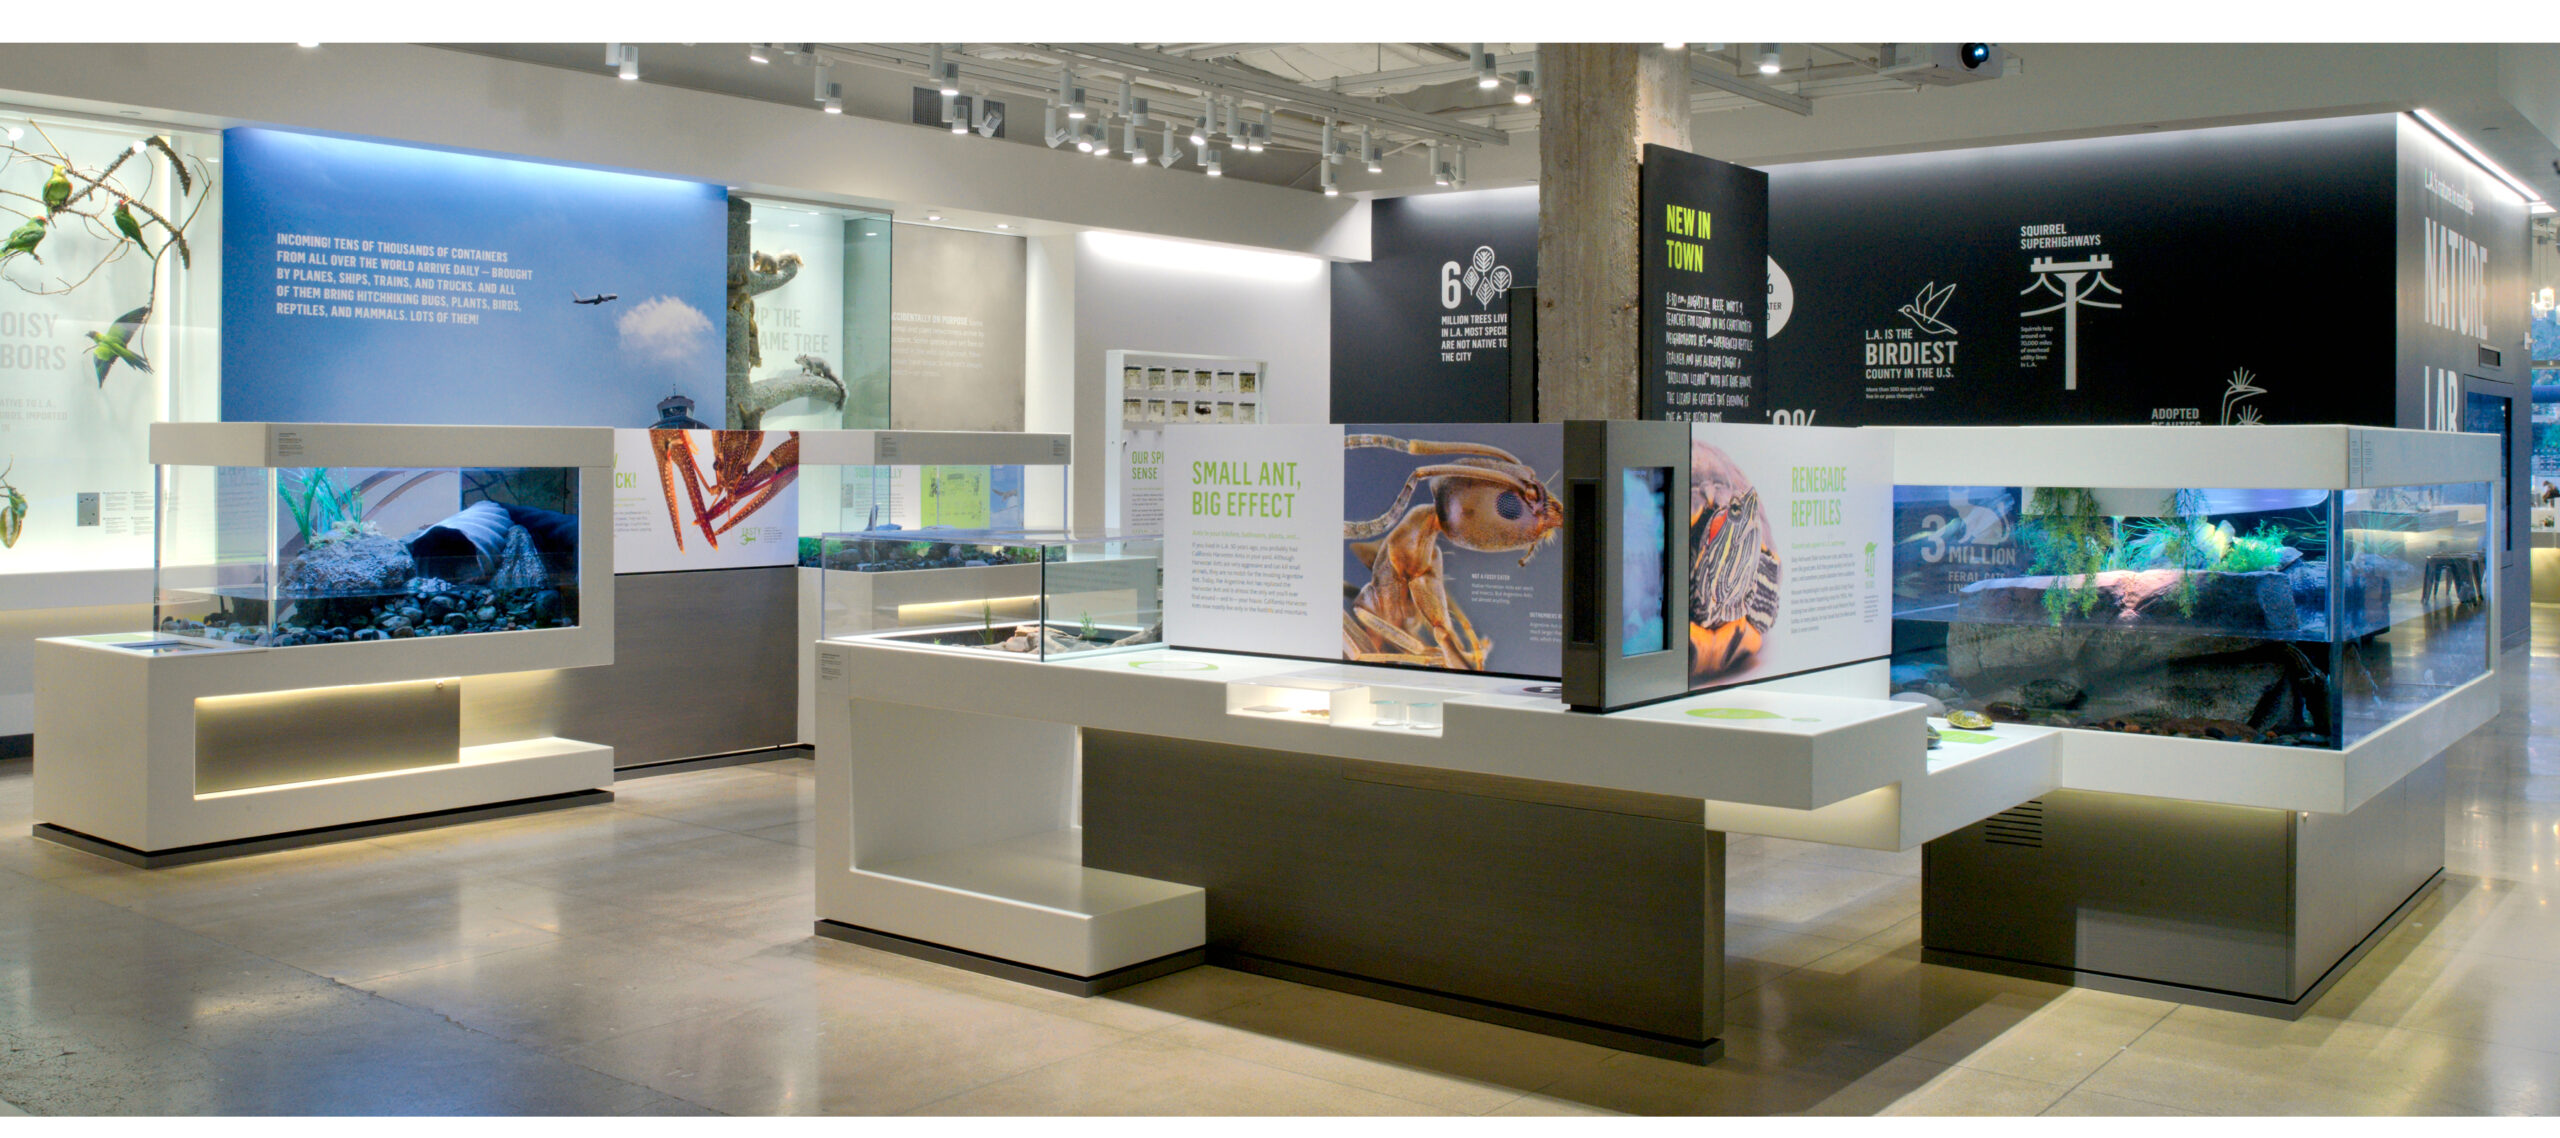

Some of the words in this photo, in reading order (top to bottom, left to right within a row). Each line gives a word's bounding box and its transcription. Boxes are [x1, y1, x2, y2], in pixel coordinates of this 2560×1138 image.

[1667, 204, 1695, 236] NEW
[1698, 211, 1710, 240] IN
[2021, 223, 2067, 237] SQUIRREL
[277, 233, 331, 249] INCOMING!
[334, 238, 359, 251] TENS
[362, 240, 374, 252] OF
[378, 241, 434, 256] THOUSANDS
[437, 246, 448, 258] OF
[452, 247, 507, 262] CONTAINERS
[2021, 234, 2101, 249] SUPERHIGHWAYS
[277, 251, 305, 264] FROM
[309, 254, 328, 266] ALL
[331, 255, 356, 268] OVER
[360, 257, 378, 269] THE
[381, 259, 414, 272] WORLD
[417, 262, 450, 274] ARRIVE
[454, 264, 479, 276] DAILY
[492, 267, 532, 280] BROUGHT
[1666, 240, 1703, 272] TOWN
[277, 268, 290, 280] BY
[294, 269, 336, 284] PLANES,
[339, 273, 371, 286] SHIPS,
[374, 275, 411, 289] TRAINS,
[415, 278, 434, 290] AND
[437, 280, 475, 292] TRUCKS.
[478, 282, 496, 294] AND
[500, 284, 516, 295] ALL
[1442, 261, 1461, 309] 6
[2425, 217, 2488, 341] NATURE
[277, 286, 290, 297] OF
[294, 287, 321, 299] THEM
[324, 289, 354, 301] BRING
[357, 291, 418, 305] HITCHHIKING
[422, 295, 448, 308] BUGS,
[452, 297, 489, 310] PLANTS,
[493, 300, 521, 312] BIRDS,
[277, 303, 328, 318] REPTILES,
[331, 306, 351, 318] AND
[355, 307, 407, 321] MAMMALS.
[411, 311, 434, 322] LOTS
[437, 312, 448, 323] OF
[452, 313, 479, 324] THEM!
[774, 307, 801, 328] THE
[1441, 315, 1469, 325] MILLION
[1471, 314, 1491, 324] TREES
[1, 312, 59, 338] OISY
[1441, 328, 1448, 337] IN
[1450, 328, 1463, 337] L.A.
[1464, 327, 1482, 336] MOST
[1866, 329, 1882, 340] L.A.
[1885, 329, 1894, 339] IS
[1896, 328, 1913, 339] THE
[793, 333, 829, 353] TREE
[1441, 340, 1454, 349] ARE
[1457, 340, 1470, 349] NOT
[1472, 339, 1496, 348] NATIVE
[1865, 341, 1958, 365] BIRDIEST
[1441, 353, 1454, 362] THE
[1456, 352, 1472, 361] CITY
[1865, 368, 1902, 379] COUNTY
[1904, 368, 1913, 379] IN
[1916, 367, 1934, 378] THE
[1936, 367, 1954, 378] U.S.
[2152, 408, 2199, 419] ADOPTED
[1131, 451, 1148, 464] OUR
[615, 472, 637, 488] CK!
[1131, 467, 1158, 480] SENSE
[1192, 461, 1252, 485] SMALL
[1259, 461, 1301, 490] ANT,
[1792, 466, 1847, 493] RENEGADE
[1192, 491, 1221, 516] BIG
[1227, 492, 1295, 518] EFFECT
[1792, 499, 1842, 528] REPTILES
[1920, 514, 1946, 563] 3
[1949, 545, 2016, 565] MILLION
